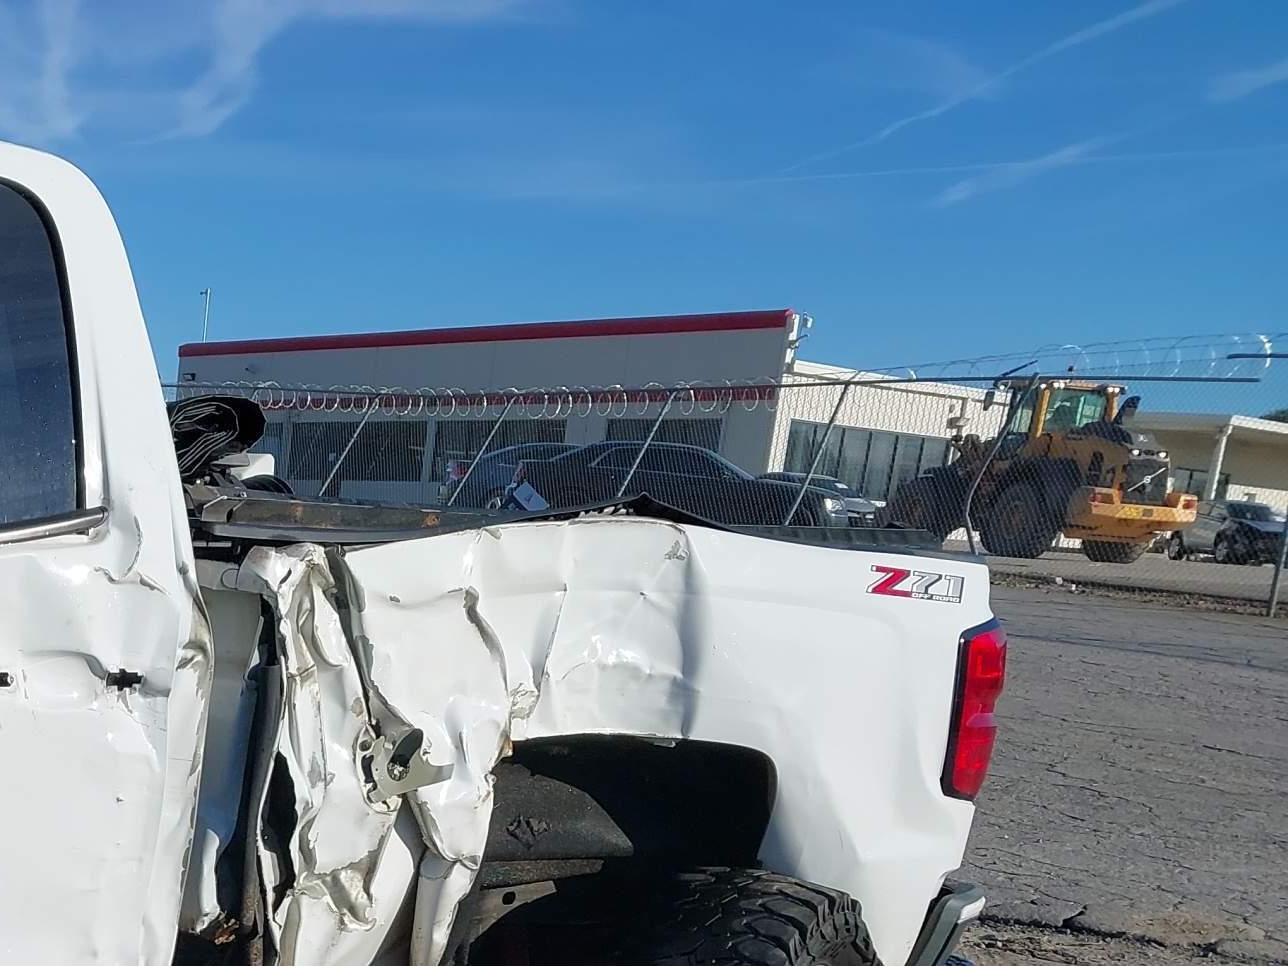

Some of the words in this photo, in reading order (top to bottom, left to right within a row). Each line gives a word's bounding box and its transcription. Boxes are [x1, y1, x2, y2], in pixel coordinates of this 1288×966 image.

[866, 565, 964, 602] Z71
[911, 592, 931, 600] OFF
[932, 595, 960, 603] ROAD
